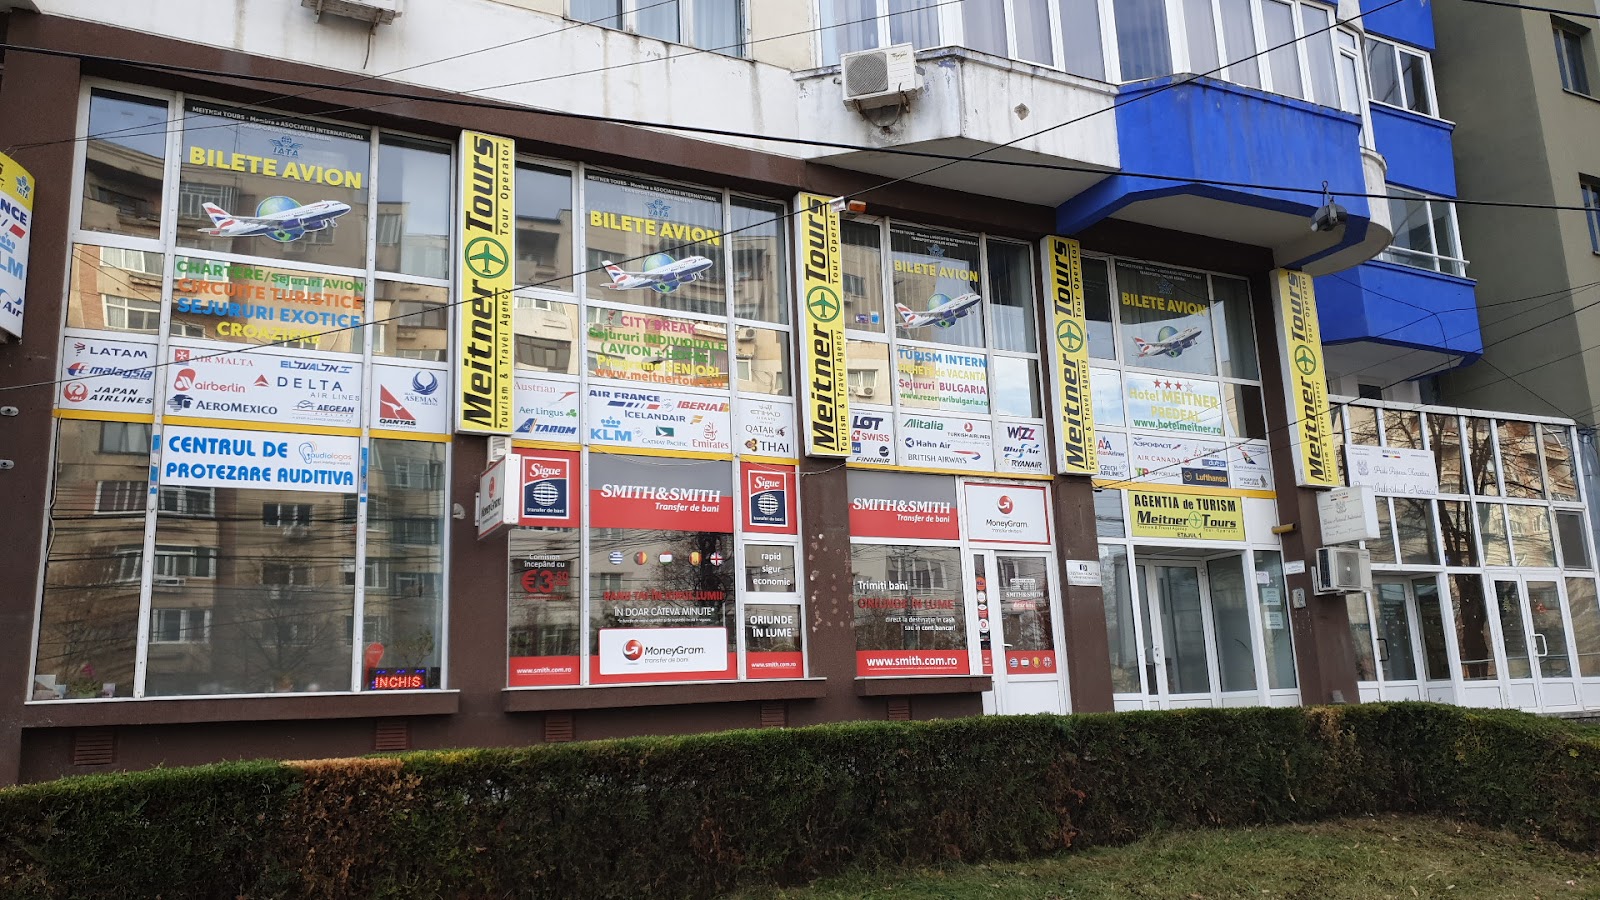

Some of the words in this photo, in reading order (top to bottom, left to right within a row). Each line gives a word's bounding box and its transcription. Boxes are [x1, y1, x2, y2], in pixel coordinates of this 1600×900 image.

[223, 111, 245, 120] TOURS
[273, 146, 299, 157] IATA
[190, 146, 277, 176] BILETE
[282, 162, 362, 189] AVION
[501, 143, 510, 200] Operator
[466, 135, 494, 234] Tours
[500, 208, 509, 236] Tour
[590, 210, 656, 236] BILETE
[660, 222, 721, 247] AVION
[806, 197, 827, 282] Tours
[894, 261, 936, 277] BILETE
[939, 267, 979, 283] AVION
[1072, 243, 1080, 290] Operator
[1054, 239, 1072, 317] Tours
[323, 279, 364, 292] AVION
[177, 278, 266, 300] CIRCUITE
[270, 287, 364, 310] TURISTICE
[1301, 276, 1311, 317] Operator
[3, 301, 22, 317] Air
[500, 288, 511, 326] Agency
[1122, 292, 1165, 311] BILETE
[1167, 300, 1207, 317] AVION
[1288, 271, 1306, 342] Tours
[177, 297, 274, 321] SEJURURI
[279, 307, 361, 329] EXOTICE
[621, 315, 651, 329] CITY
[654, 319, 697, 335] BREAK
[217, 321, 321, 345] CROAZIERE
[588, 327, 640, 342] Sejururi
[643, 334, 725, 351] INDIVIDUALE
[90, 346, 148, 359] LATAM
[500, 332, 509, 366] Travel
[609, 344, 651, 357] AVION
[836, 330, 844, 363] Agency
[462, 279, 493, 428] Meitner
[898, 349, 942, 363] TURISM
[945, 354, 987, 368] INTERN
[192, 355, 212, 365] AIR
[215, 357, 254, 367] MALTA
[90, 366, 153, 379] malaysia
[95, 386, 139, 395] JAPAN
[195, 380, 246, 393] airberlin
[277, 377, 343, 392] DELTA
[514, 381, 556, 393] Austrian
[812, 322, 836, 452] Meitner
[899, 378, 935, 391] Sejururi
[939, 382, 987, 395] BULGARIA
[89, 394, 153, 404] AIRLINES
[310, 391, 328, 399] AIR
[404, 395, 438, 404] ASEMAN
[589, 390, 610, 399] AIR
[614, 392, 661, 403] FRANCE
[1129, 388, 1159, 402] Hotel
[1162, 390, 1219, 410] MEITNER
[317, 404, 355, 413] AEGEAN
[499, 387, 509, 429] Tourism
[519, 406, 534, 414] Aer
[535, 408, 564, 419] Lingus
[677, 401, 721, 412] IBERIA
[1062, 353, 1085, 469] Meitner
[1151, 406, 1201, 423] PREDEAL
[535, 424, 577, 435] TAROM
[745, 425, 774, 434] QATAR
[853, 415, 884, 431] LOT
[903, 418, 944, 431] Alitalia
[1133, 418, 1222, 435] www.hotelmeitner.ro
[1301, 376, 1325, 482] Meitner
[590, 428, 632, 442] KLM
[862, 432, 890, 442] SWISS
[168, 435, 256, 457] CENTRUL
[263, 441, 288, 459] DE
[692, 439, 729, 449] Emirates
[760, 441, 789, 453] THAI
[916, 440, 937, 448] Hahn
[1003, 446, 1025, 454] Blue
[855, 456, 891, 464] FINNAIR
[908, 454, 936, 462] BRITISH
[1011, 459, 1042, 469] RYANAIR
[1151, 456, 1181, 464] CANADA
[166, 462, 272, 482] PROTEZARE
[277, 467, 354, 486] AUDITIVA
[529, 463, 561, 478] Sigue
[754, 476, 780, 490] Sigue
[1195, 473, 1227, 483] Lufthansa
[601, 483, 721, 503] SMITH&SMITH
[655, 502, 689, 513] Transfer
[690, 503, 700, 512] de
[702, 504, 719, 513] bani
[853, 498, 950, 514] SMITH&SMITH
[1134, 494, 1180, 509] AGENTIA
[1183, 499, 1194, 510] de
[1196, 498, 1237, 512] TURISM
[897, 513, 925, 524] Transfer
[926, 515, 934, 523] de
[935, 515, 950, 523] bani
[1137, 511, 1188, 525] Meitner
[1202, 514, 1237, 528] Tours
[524, 560, 556, 569] începând
[761, 553, 781, 563] rapid
[762, 565, 781, 574] sigur
[753, 577, 791, 586] economic
[889, 581, 908, 591] bani
[614, 606, 623, 617] ÎN
[625, 608, 649, 616] DOAR
[750, 615, 793, 625] ORIUNDE
[752, 626, 764, 638] ÎN
[751, 661, 797, 669] www.smith.com.ro
[867, 656, 958, 667] www.smith.com.ro
[375, 676, 421, 688] INCHIS
